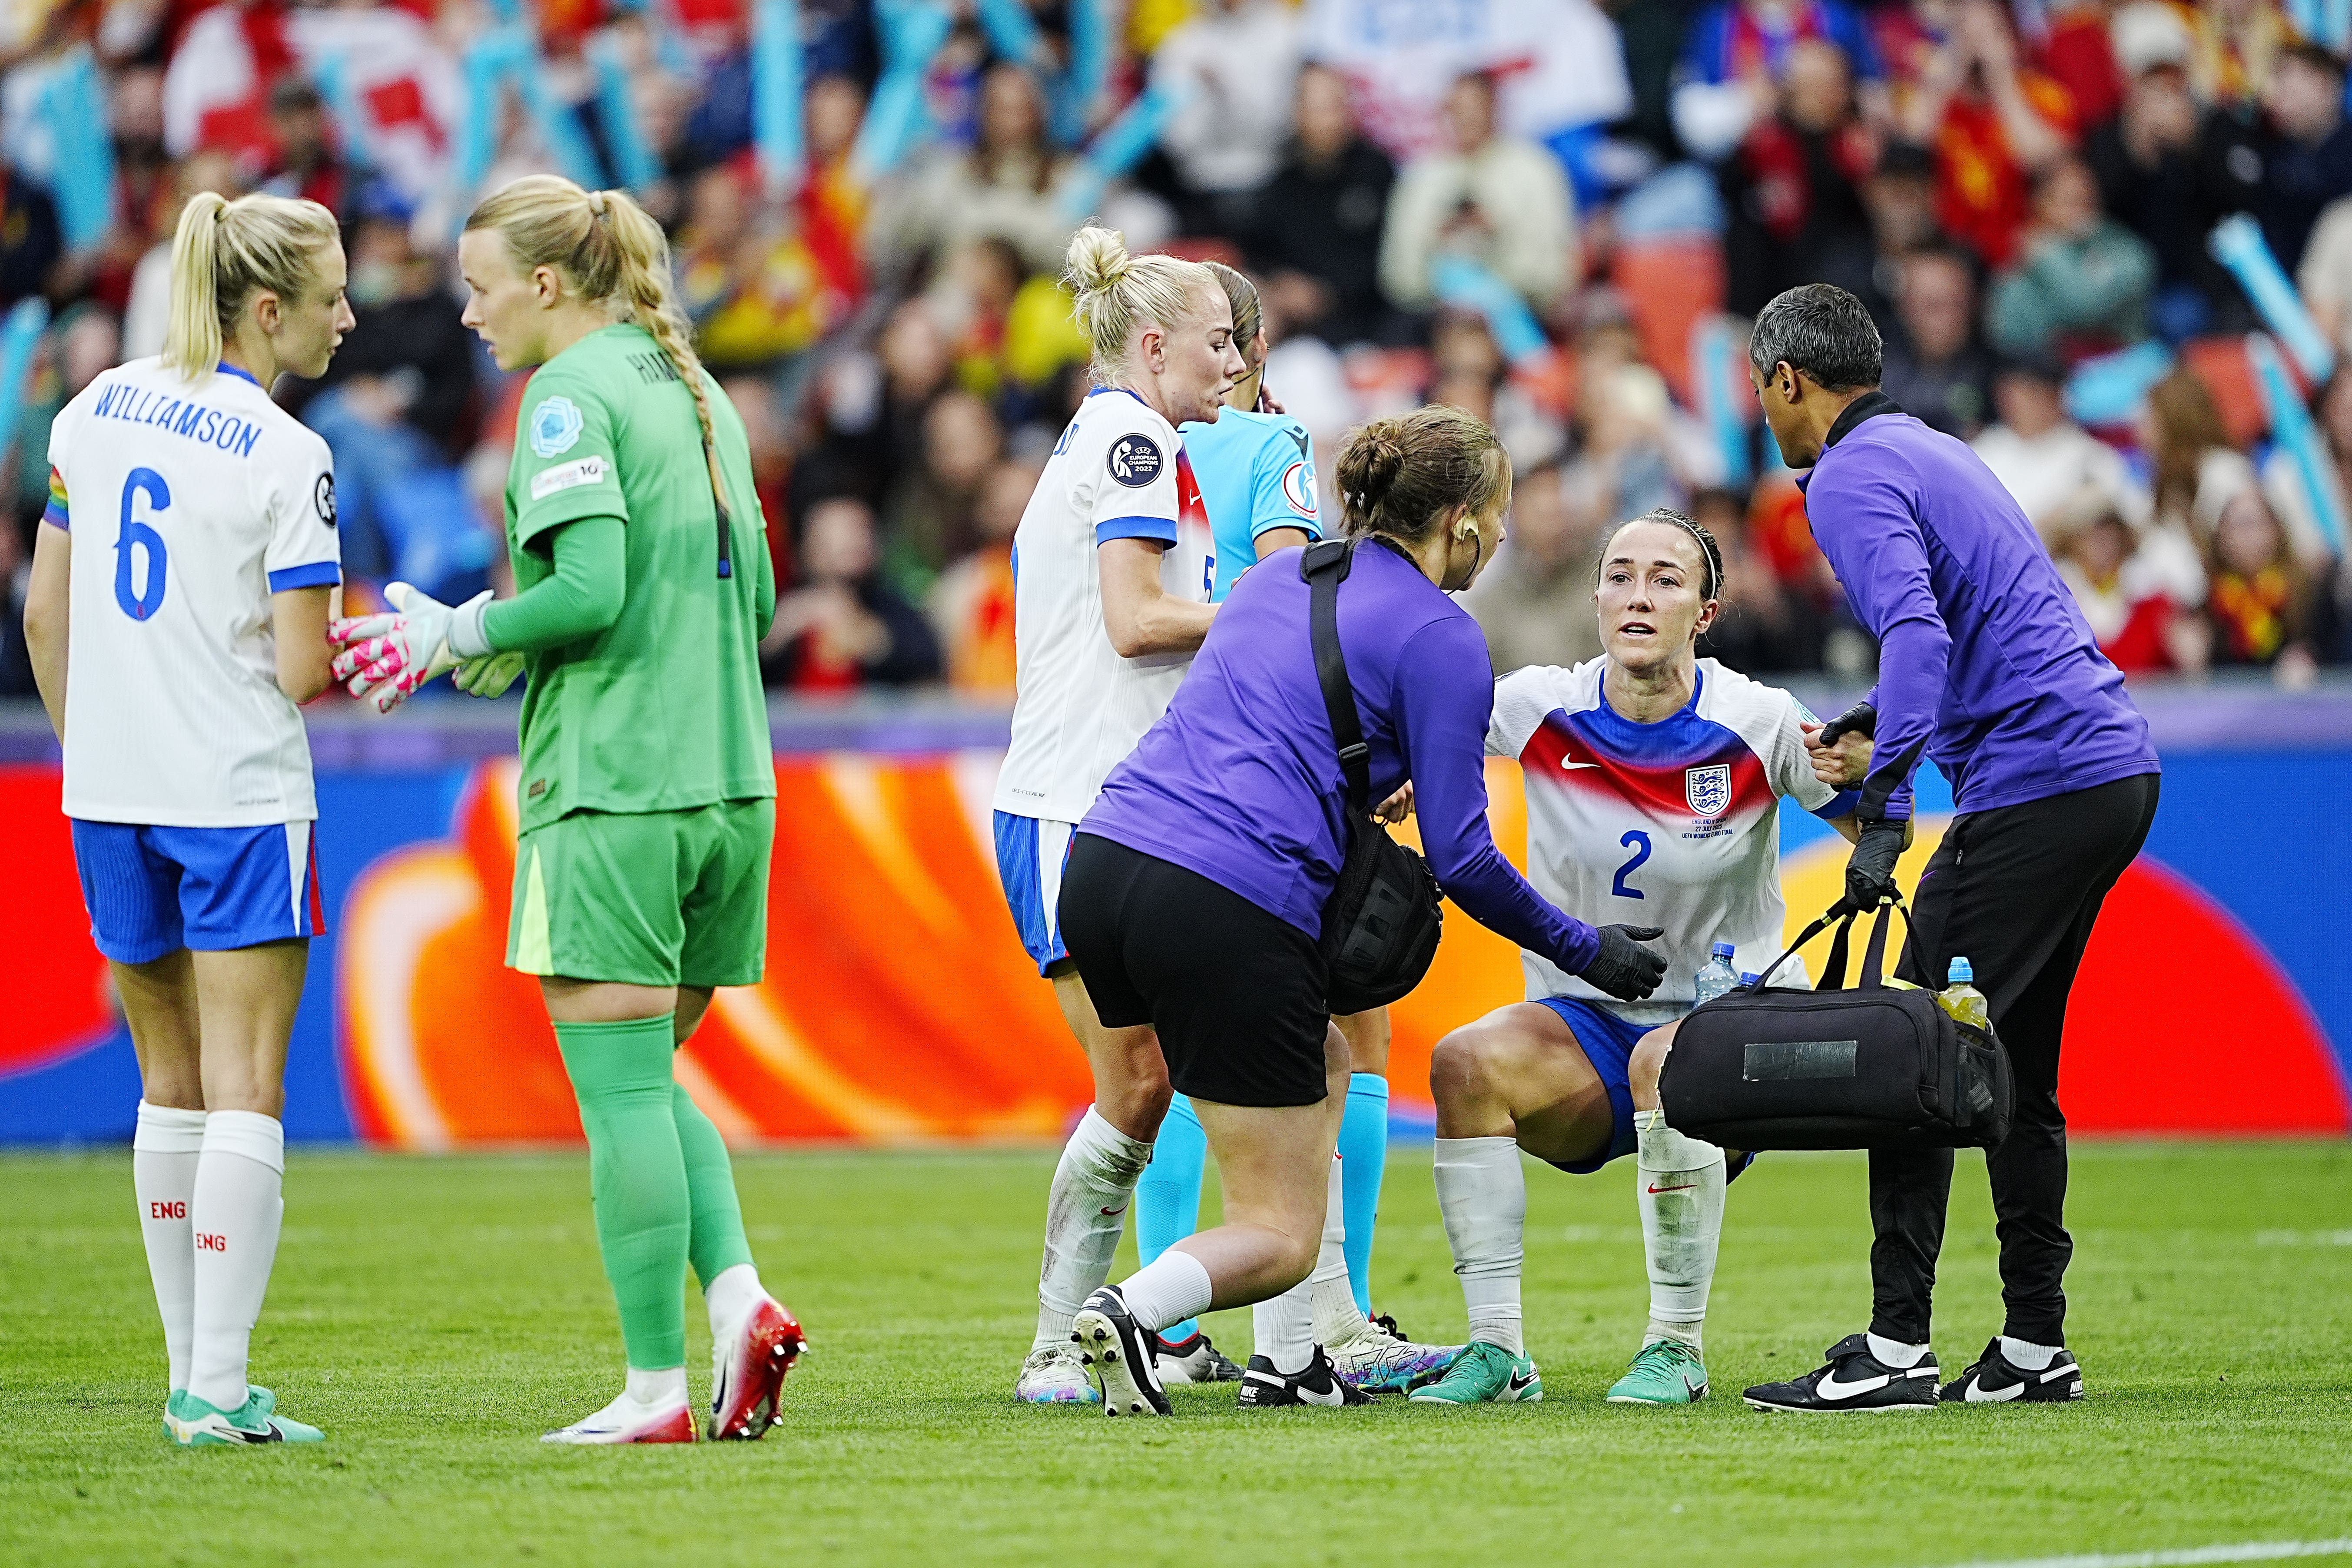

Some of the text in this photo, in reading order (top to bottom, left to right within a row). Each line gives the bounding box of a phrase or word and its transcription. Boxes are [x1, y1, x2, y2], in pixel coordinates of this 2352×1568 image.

[94, 384, 262, 457] WILLIAMSON
[1135, 447, 1152, 455] UEFA
[113, 467, 170, 621] 6
[1611, 830, 1652, 900] 2
[151, 1202, 186, 1219] ENG
[196, 1233, 226, 1251] ENG
[1240, 1385, 1259, 1397] NIKE
